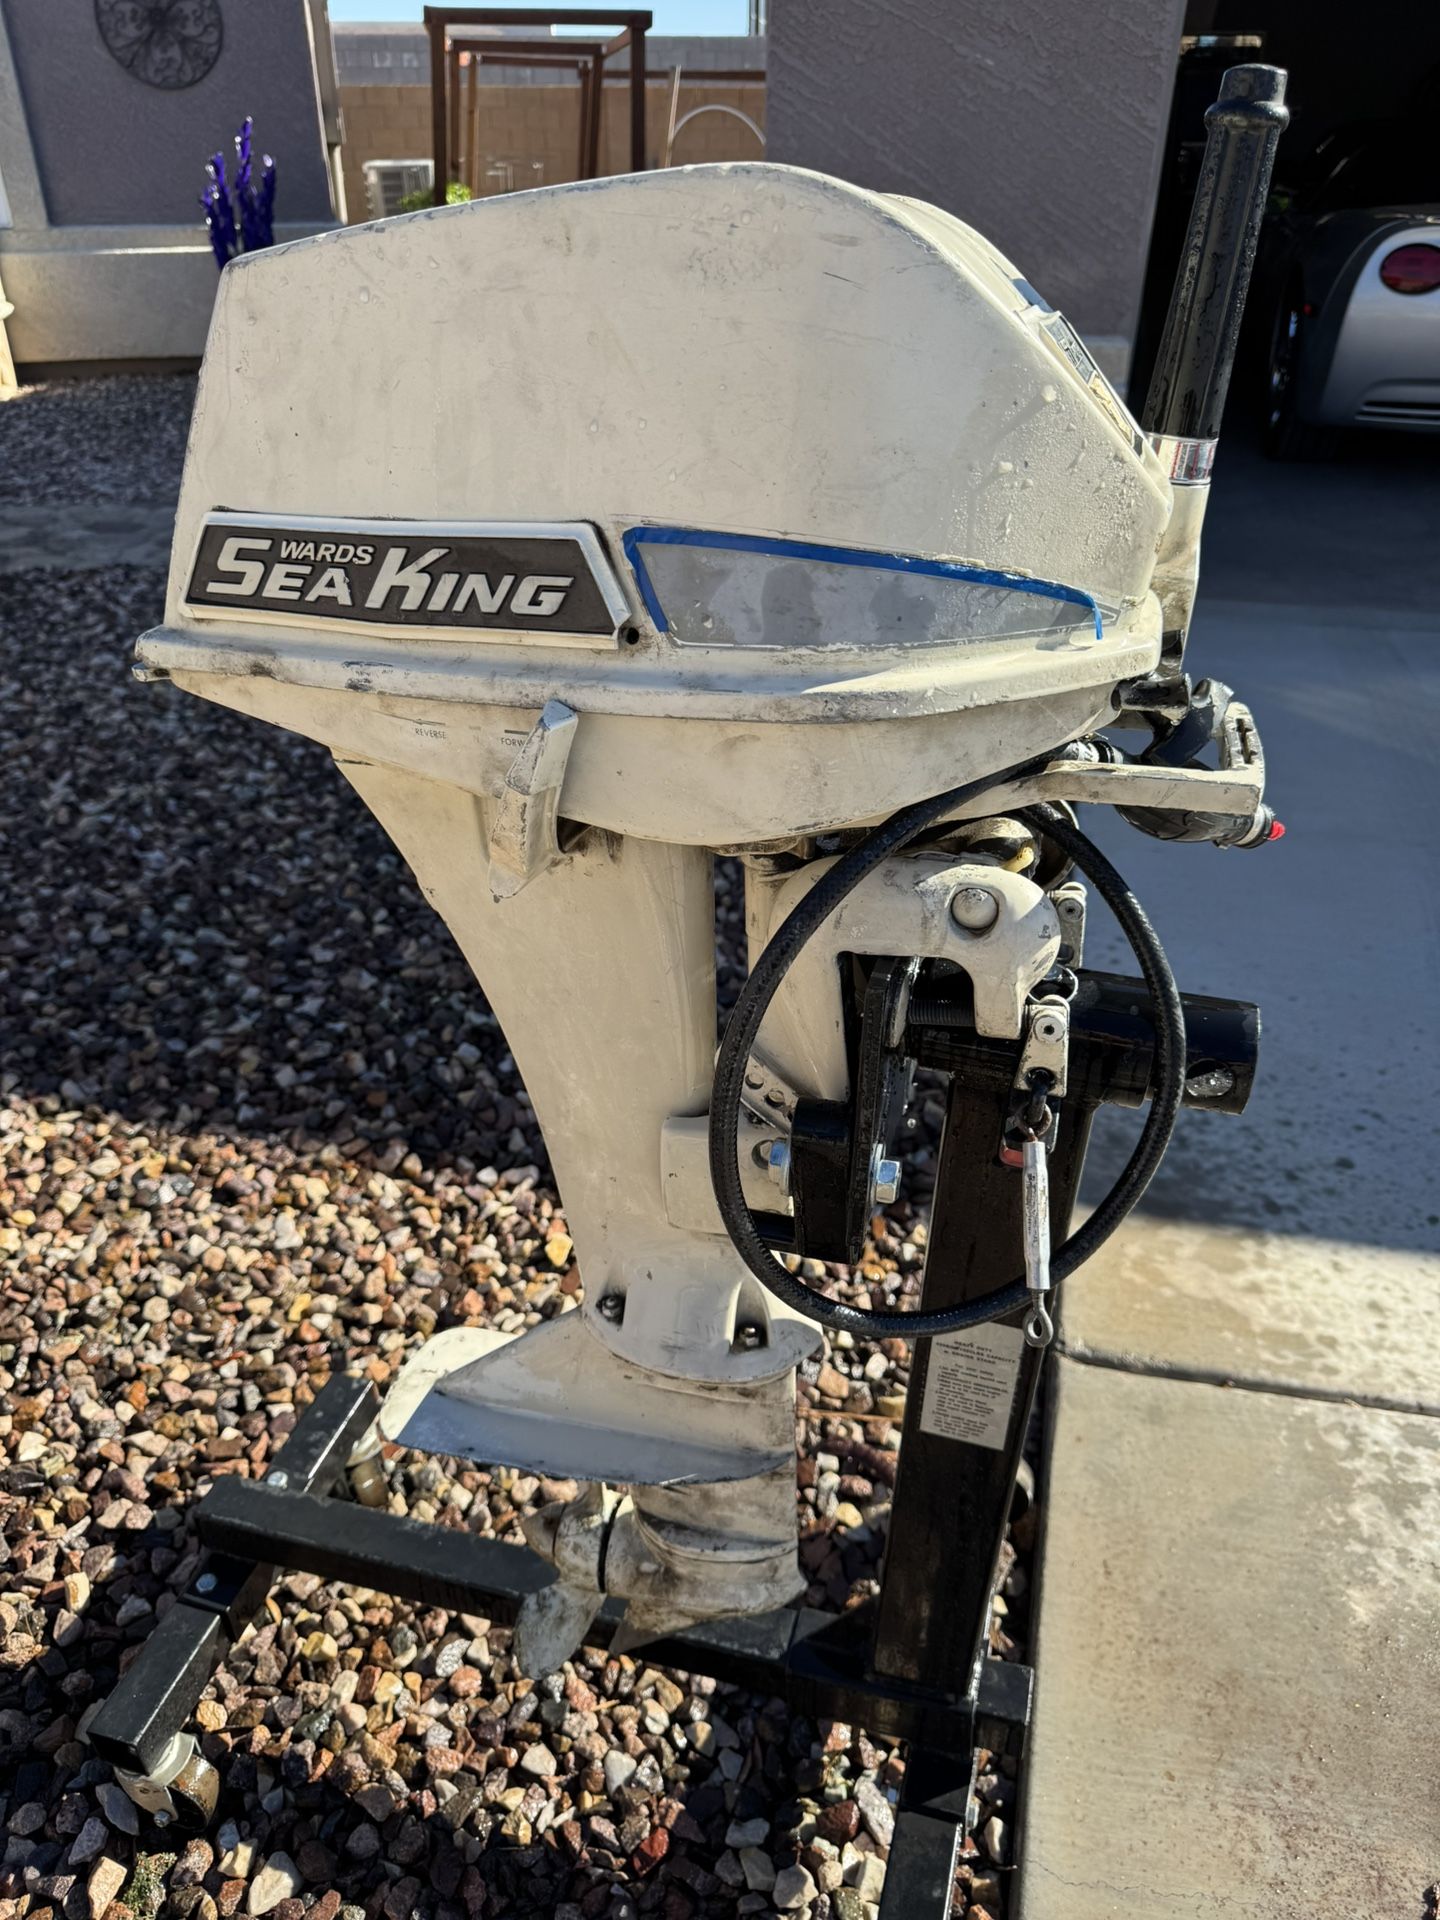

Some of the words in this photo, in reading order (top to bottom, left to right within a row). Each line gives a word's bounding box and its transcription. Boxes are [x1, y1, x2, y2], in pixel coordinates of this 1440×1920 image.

[280, 539, 375, 566] WARDS
[206, 536, 354, 607] SEA
[365, 546, 575, 617] KING
[415, 728, 446, 739] REVERSE
[501, 737, 527, 747] FORW
